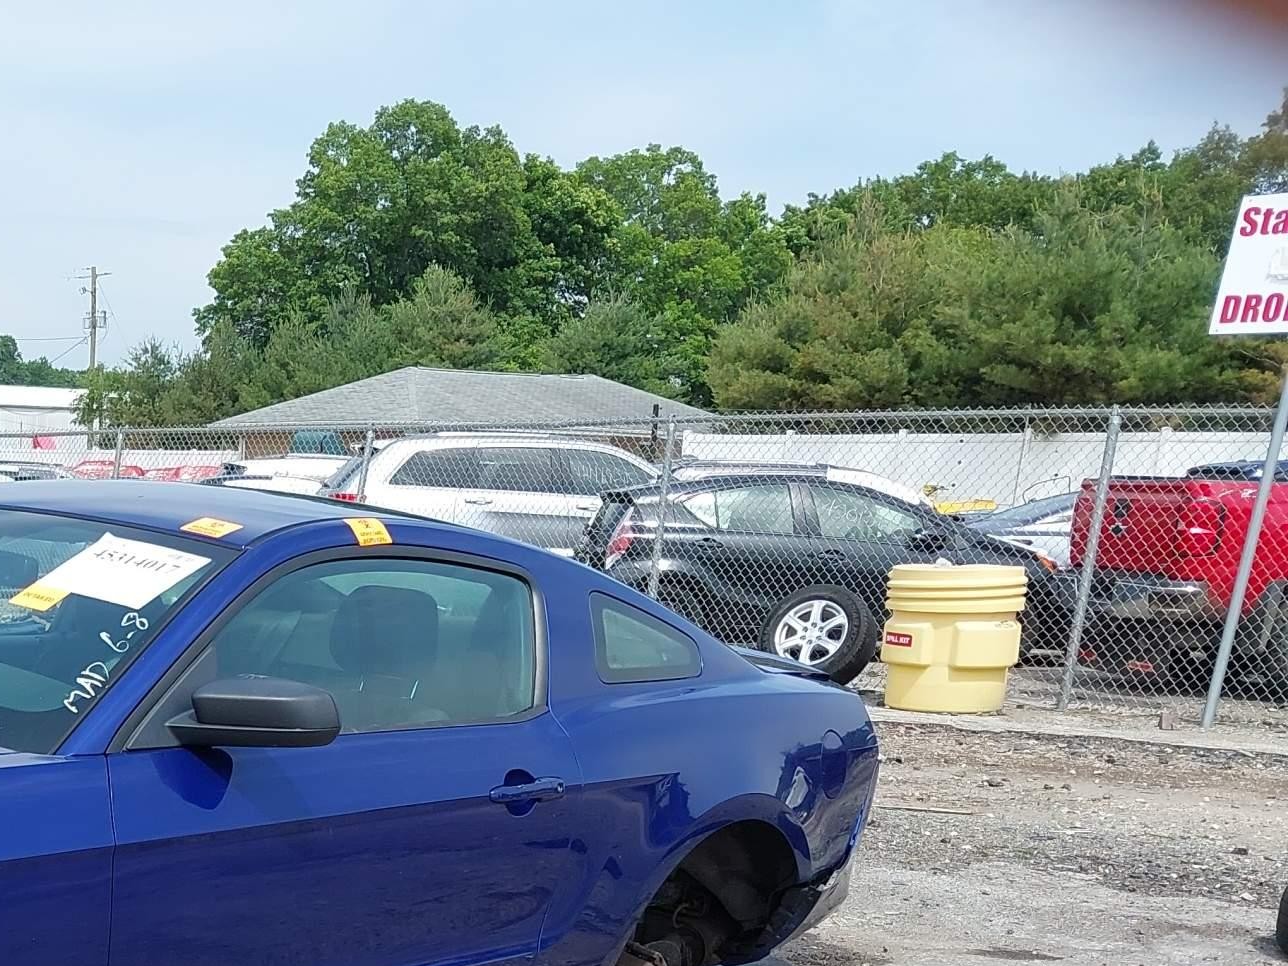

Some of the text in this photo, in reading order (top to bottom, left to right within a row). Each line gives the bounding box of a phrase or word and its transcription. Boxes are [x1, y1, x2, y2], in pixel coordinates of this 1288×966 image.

[1219, 292, 1288, 323] DRO
[63, 612, 149, 714] MAD 6-8
